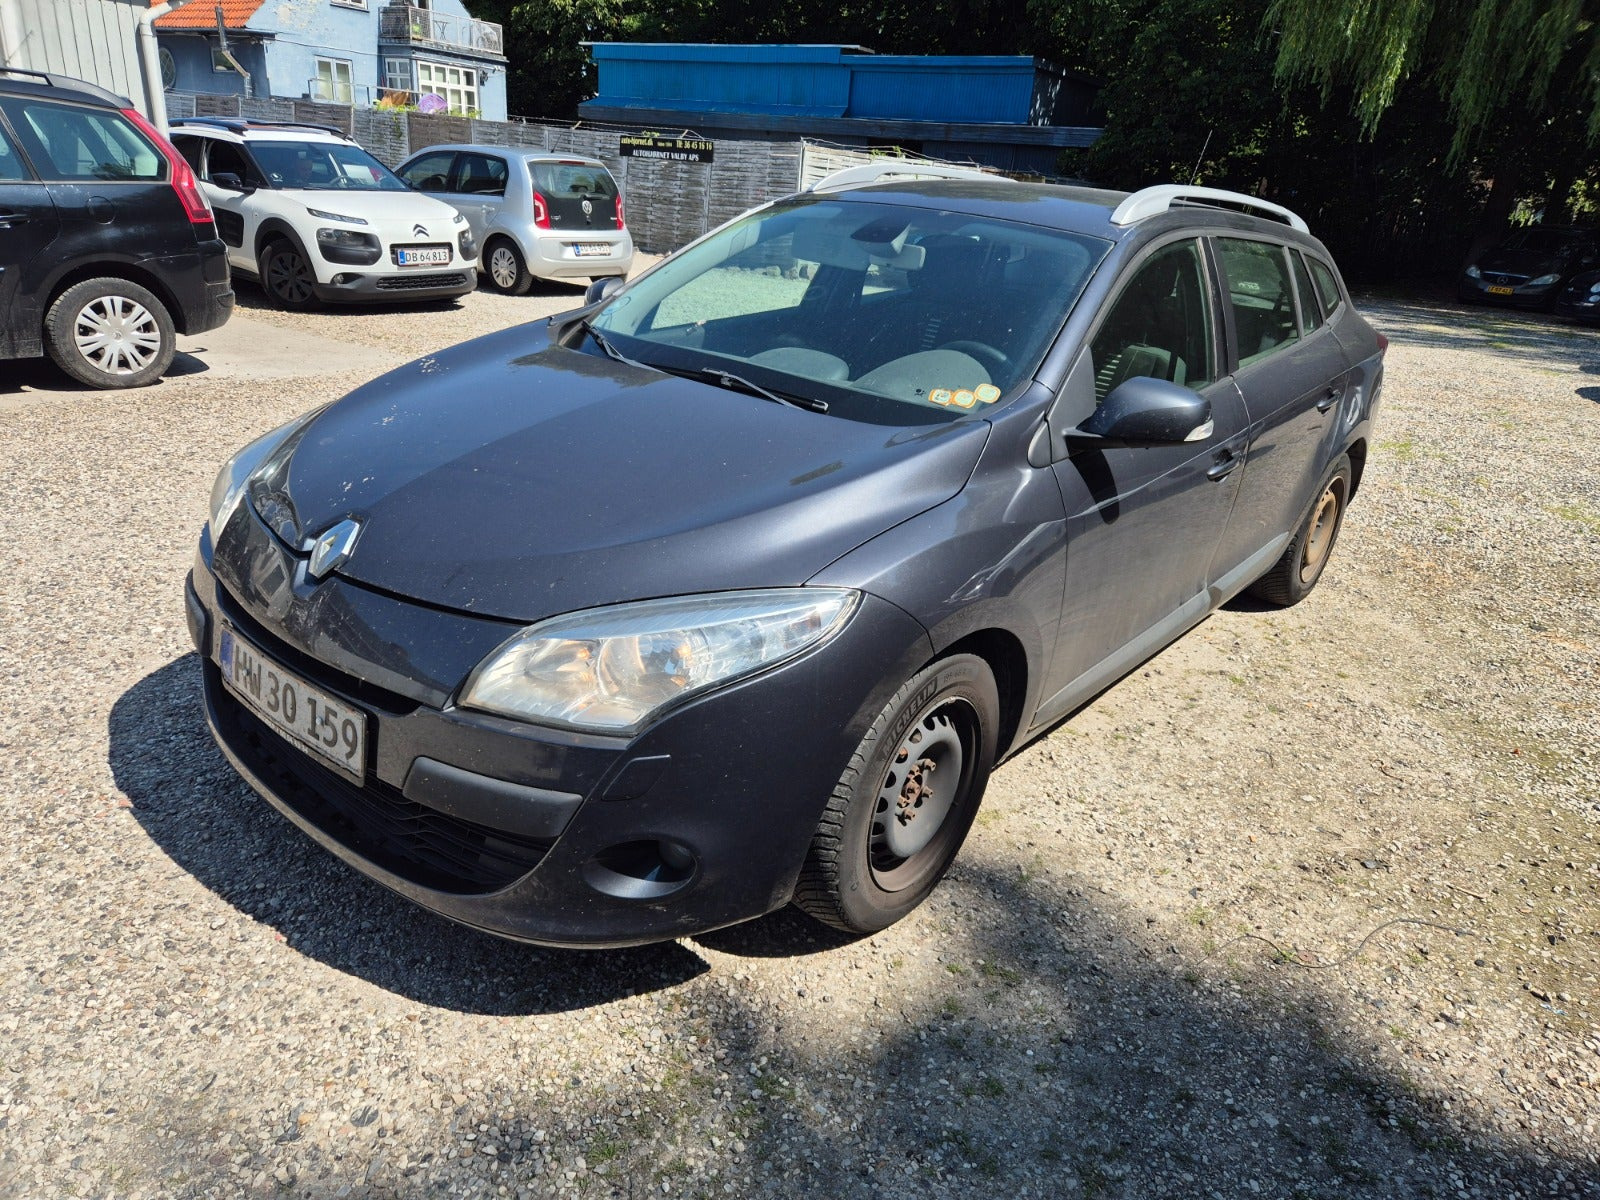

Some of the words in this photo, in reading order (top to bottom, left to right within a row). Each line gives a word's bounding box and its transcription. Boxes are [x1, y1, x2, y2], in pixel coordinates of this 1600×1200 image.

[691, 141, 698, 150] 45
[671, 152, 688, 161] VALBY
[688, 153, 699, 162] APS
[405, 252, 418, 262] DB
[420, 252, 431, 262] 64
[432, 251, 447, 262] 813
[266, 671, 297, 724] 30
[307, 697, 358, 760] 159
[883, 680, 936, 755] MICHELIN
